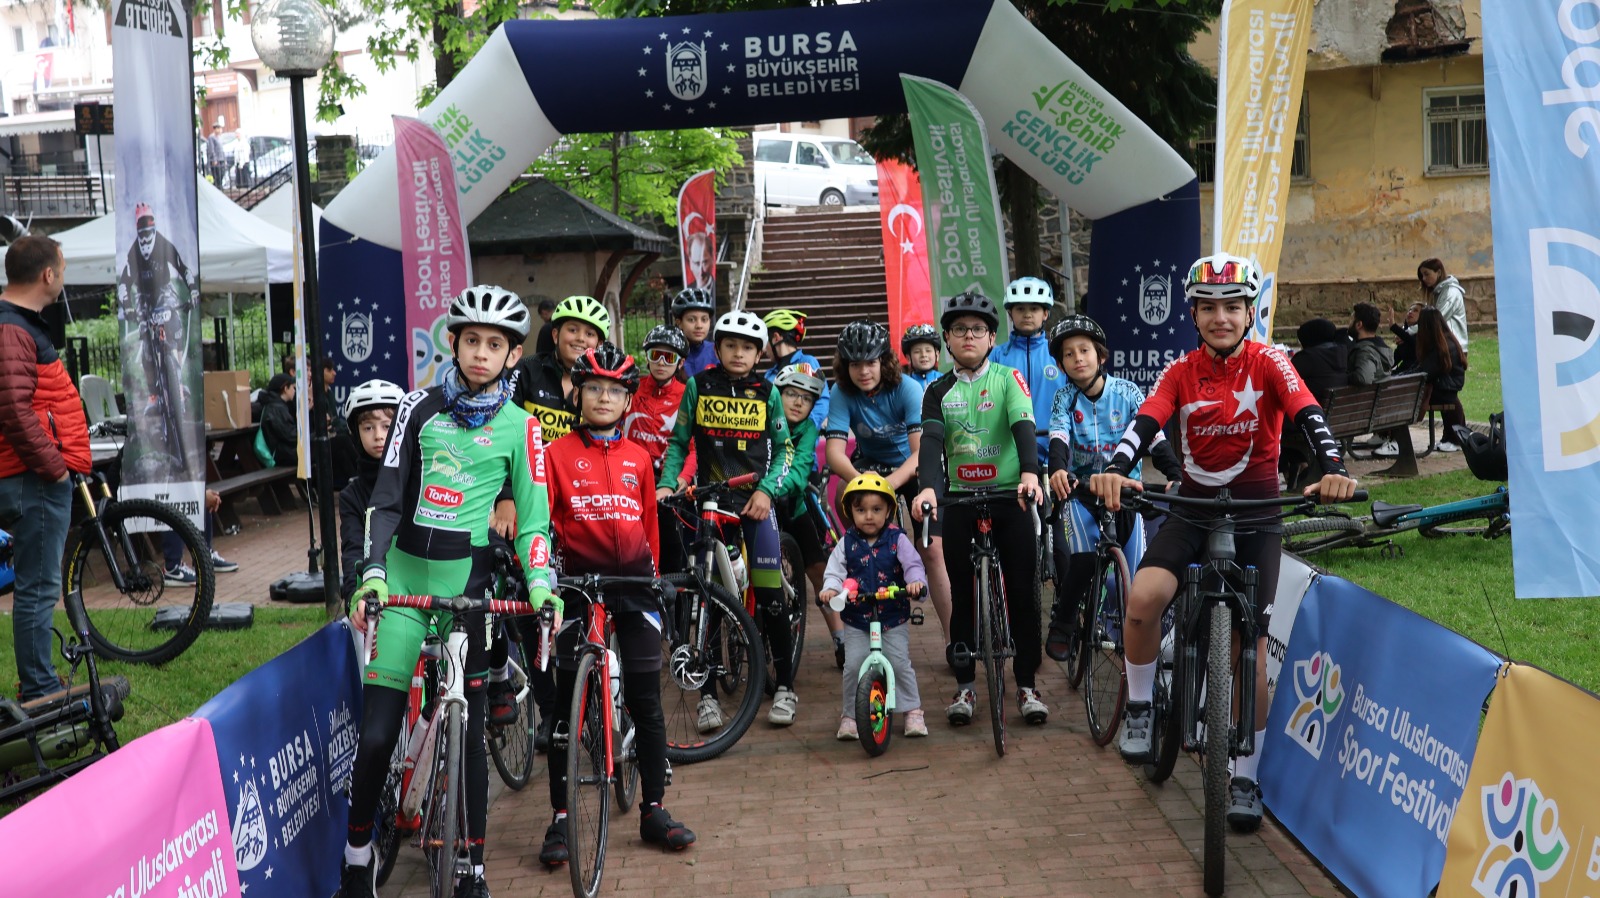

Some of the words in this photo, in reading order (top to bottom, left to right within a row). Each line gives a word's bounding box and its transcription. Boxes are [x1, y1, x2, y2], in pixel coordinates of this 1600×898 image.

[744, 30, 858, 58] BURSA
[746, 53, 858, 78] BÜYÜKŞEHİR
[747, 73, 860, 97] BELEDİYESİ
[1264, 12, 1296, 153] Festivali
[1242, 9, 1265, 162] Uluslararası
[459, 145, 506, 194] LÜBÜ
[1001, 120, 1085, 185] KULÜBÜ
[1238, 172, 1259, 244] Bursa
[1260, 160, 1280, 244] Spor
[509, 369, 521, 399] ONYA
[1114, 368, 1162, 381] BÜYÜK
[533, 408, 576, 431] KON
[704, 400, 759, 415] KONYA
[704, 429, 760, 439] ALCANO
[960, 468, 992, 478] Torku
[429, 488, 459, 504] Torku
[571, 495, 639, 510] SPORTOTO
[1352, 683, 1389, 732] Bursa
[269, 729, 314, 790] BURSA
[1338, 724, 1383, 786] Spor
[281, 786, 320, 847] BELEDİYESİ
[178, 847, 228, 898] ivali
